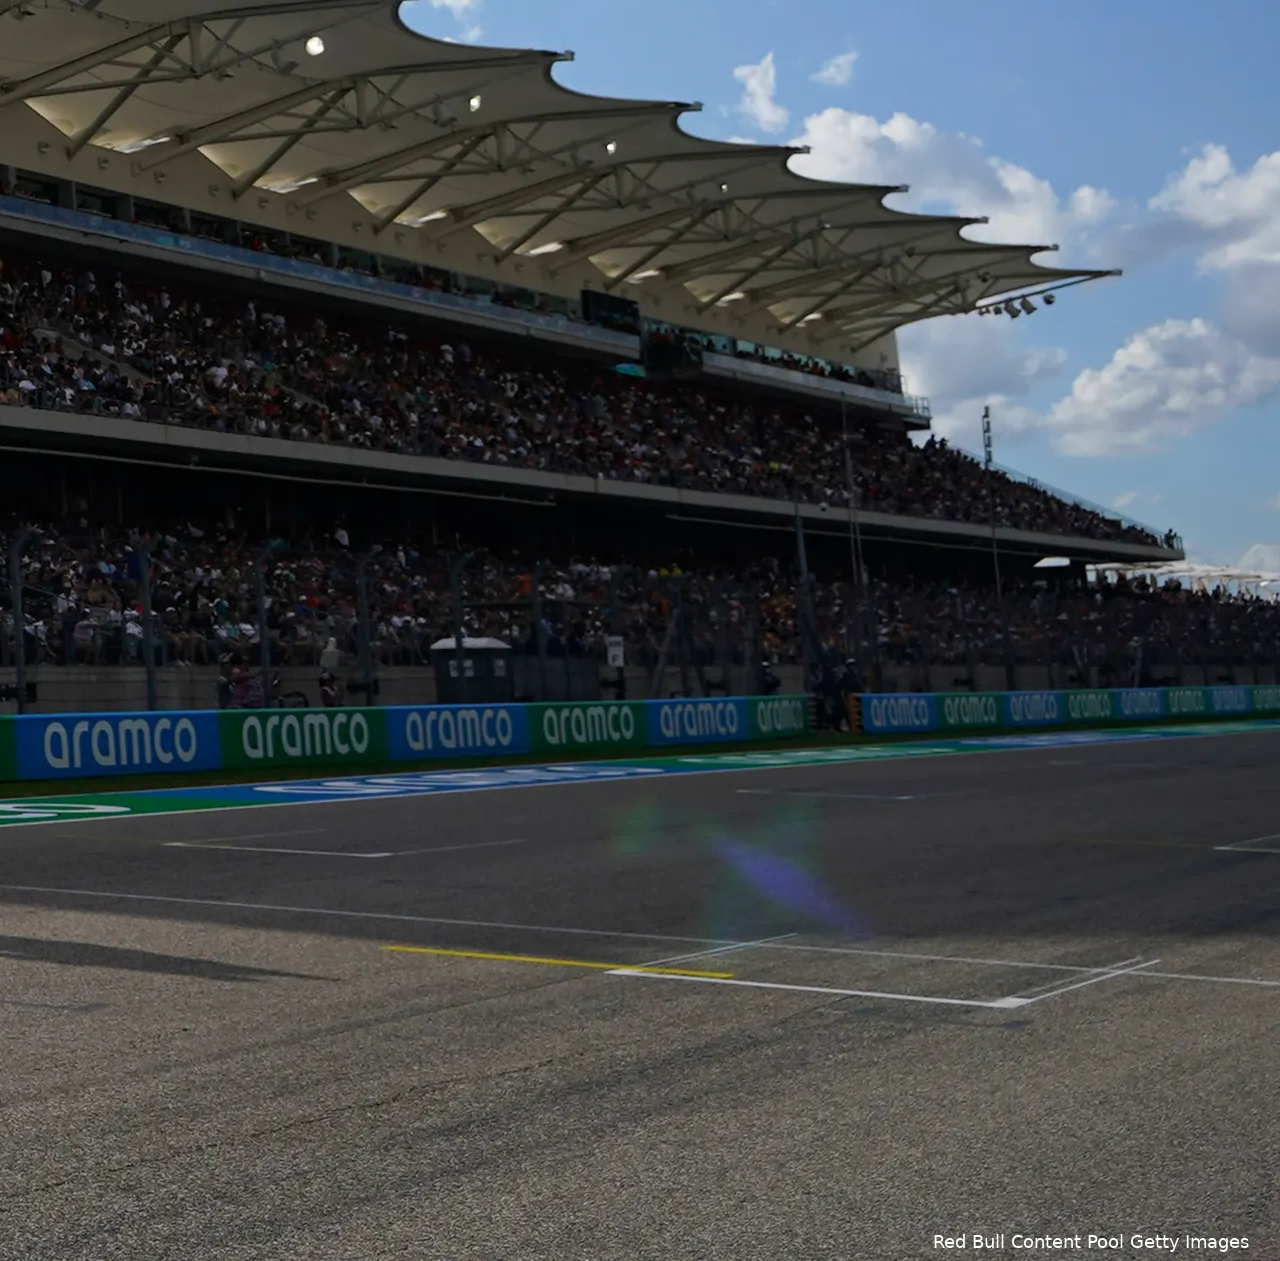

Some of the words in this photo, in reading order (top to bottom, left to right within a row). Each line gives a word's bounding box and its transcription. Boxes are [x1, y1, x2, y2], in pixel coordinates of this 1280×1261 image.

[544, 705, 634, 744] aramco
[661, 703, 738, 736] aramco
[757, 700, 804, 732] aramco
[871, 698, 928, 727] aramco
[944, 696, 997, 725] aramco
[45, 718, 195, 767] aramco
[243, 713, 368, 758] aramco
[407, 709, 512, 750] aramco
